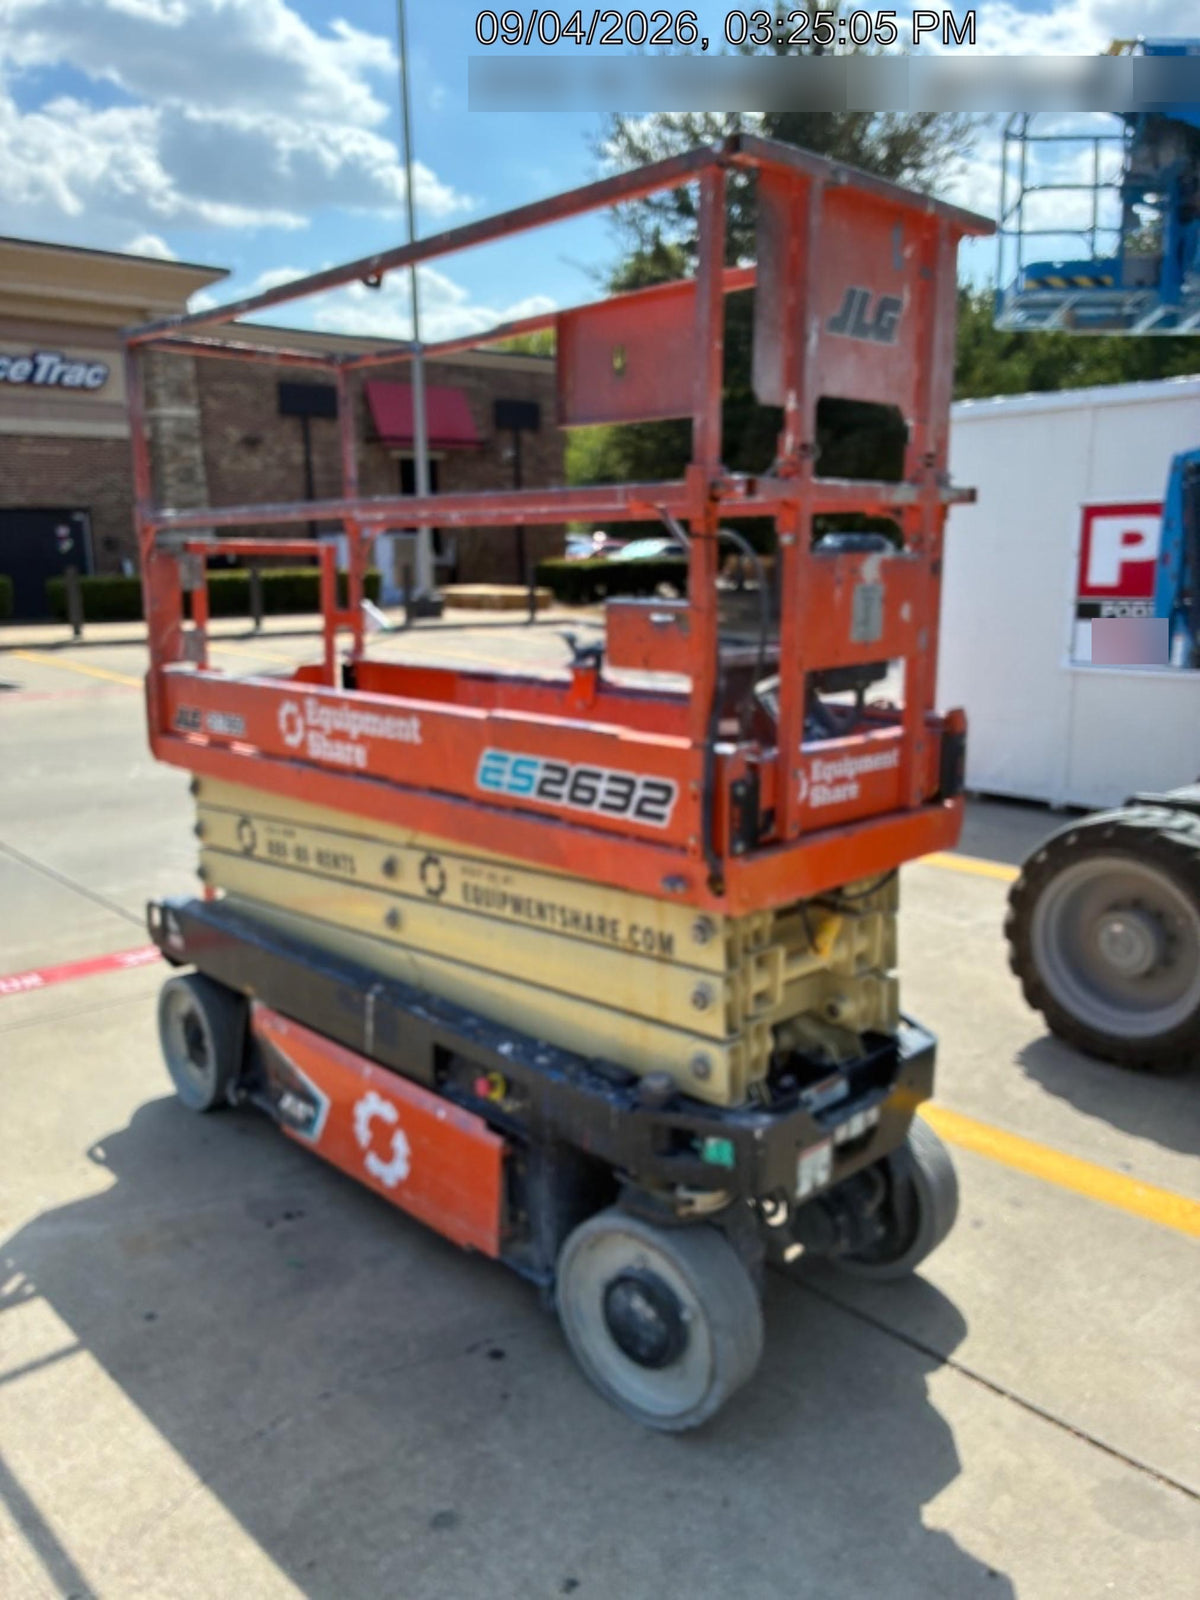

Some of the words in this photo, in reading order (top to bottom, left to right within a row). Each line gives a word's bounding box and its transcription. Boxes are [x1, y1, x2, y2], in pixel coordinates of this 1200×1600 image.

[826, 286, 904, 344] JLG
[305, 697, 422, 744] Equipment
[307, 729, 368, 767] Share
[810, 747, 900, 784] Equipment
[478, 749, 677, 827] ES2632
